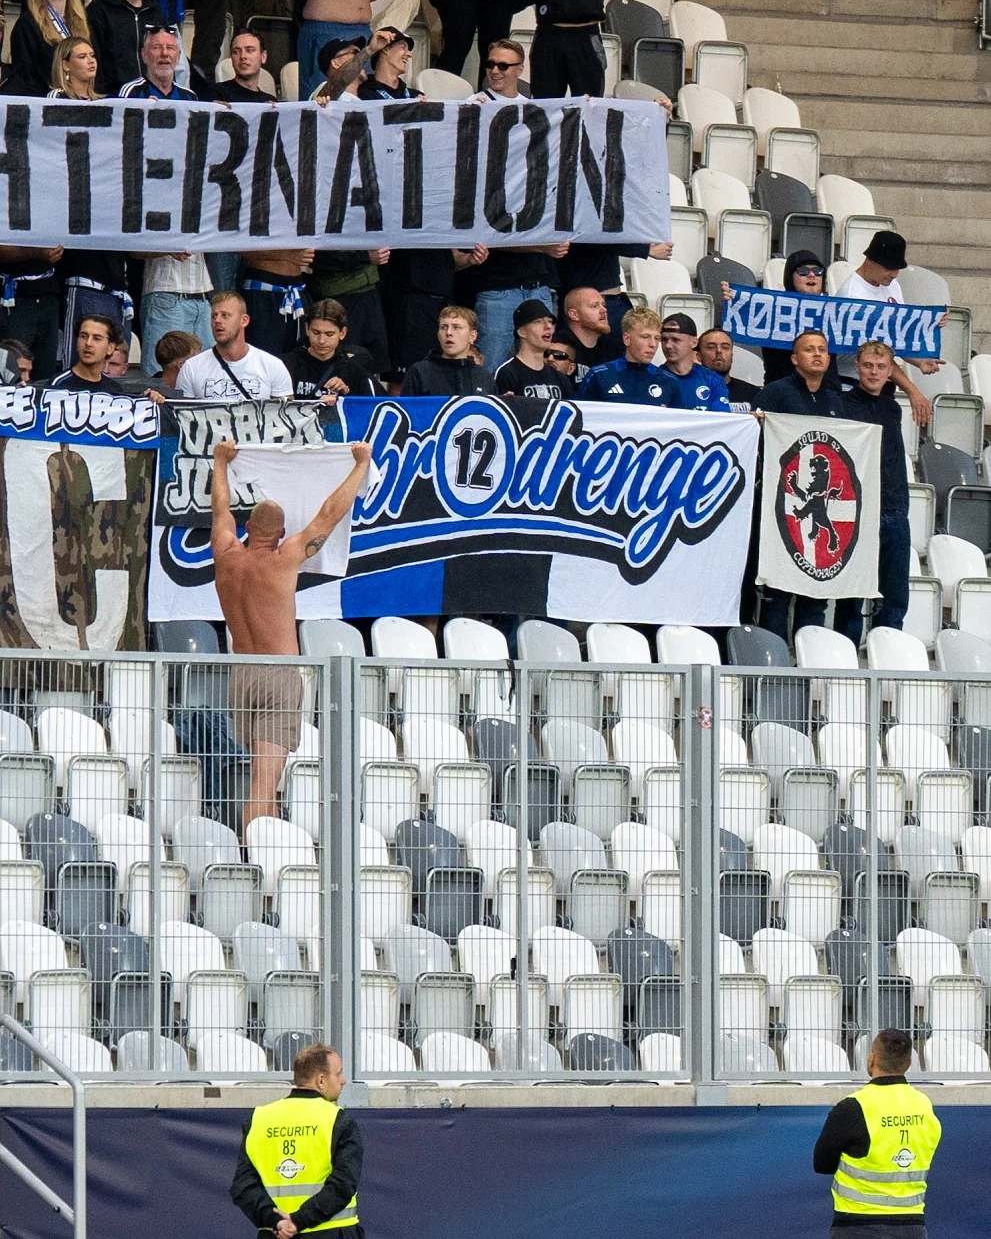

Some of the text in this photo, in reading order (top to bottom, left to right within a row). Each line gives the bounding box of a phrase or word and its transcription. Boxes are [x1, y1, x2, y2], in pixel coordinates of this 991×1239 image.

[722, 289, 944, 352] KØBENHAVN
[41, 388, 158, 443] TUBBE
[798, 431, 828, 449] SQUAD
[453, 427, 498, 490] 12
[793, 551, 843, 579] COPENHAGEN
[881, 1114, 925, 1128] SECURITY
[266, 1125, 318, 1139] SECURITY
[899, 1129, 909, 1145] 71
[282, 1139, 296, 1156] 85
